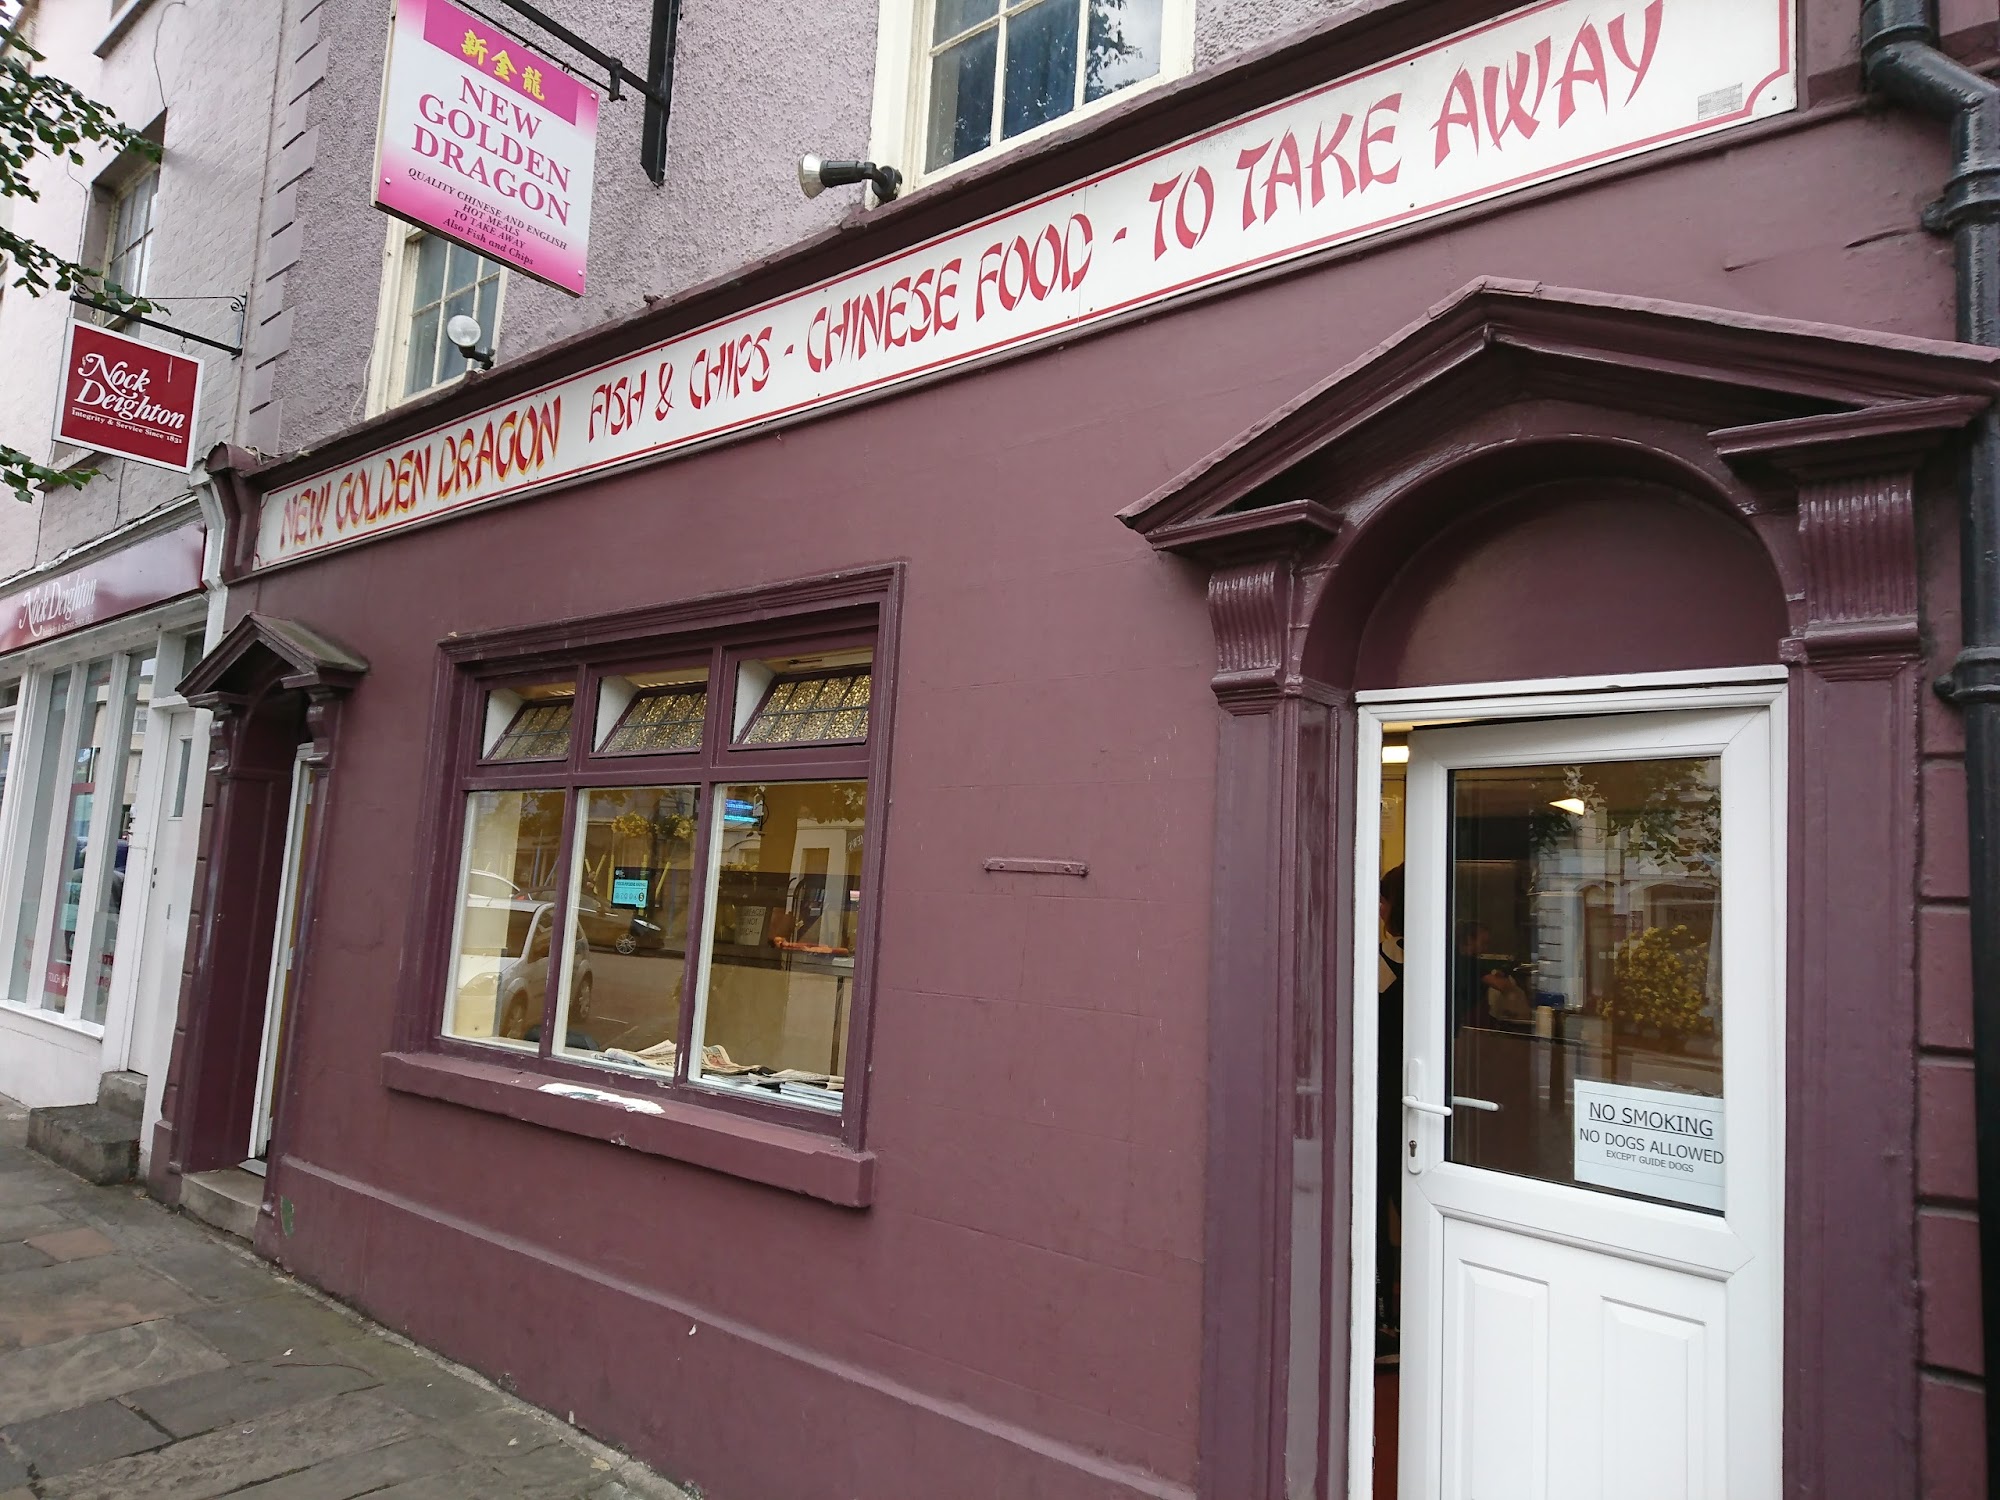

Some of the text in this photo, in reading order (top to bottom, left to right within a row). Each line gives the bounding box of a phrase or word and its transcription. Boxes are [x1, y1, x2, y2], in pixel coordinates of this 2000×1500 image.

[461, 29, 545, 101] 新金龍
[459, 75, 542, 140] NEW
[418, 93, 571, 194] GOLDEN
[411, 123, 571, 227] DRAGON
[408, 168, 568, 250] QUALITY CHINESE AND ENGLISH
[454, 209, 526, 249] TO TAKE AWAY
[462, 204, 521, 237] HOT MEALS
[442, 217, 534, 265] Also Fish and Chips
[280, 480, 332, 552] NEW
[335, 443, 432, 533] GOLDEN
[437, 394, 562, 500] DRAGON
[588, 369, 647, 443] FISH
[655, 362, 674, 421] &
[689, 326, 773, 409] CHIPS
[806, 257, 962, 373] CHINESE
[975, 210, 1093, 322] FOOD
[1148, 164, 1215, 262] TO
[1235, 92, 1403, 232] TAKE
[1430, 0, 1664, 170] AWAY
[77, 353, 151, 399] Nock
[71, 408, 107, 424] Integrity
[116, 421, 143, 434] Service
[144, 428, 165, 439] Since
[74, 378, 186, 429] Deighton
[1589, 1102, 1714, 1137] NO SMOKING
[1579, 1128, 1724, 1164] NO DOGS ALLOWED
[1606, 1150, 1694, 1173] EXCEPT GUIDE DOGS
